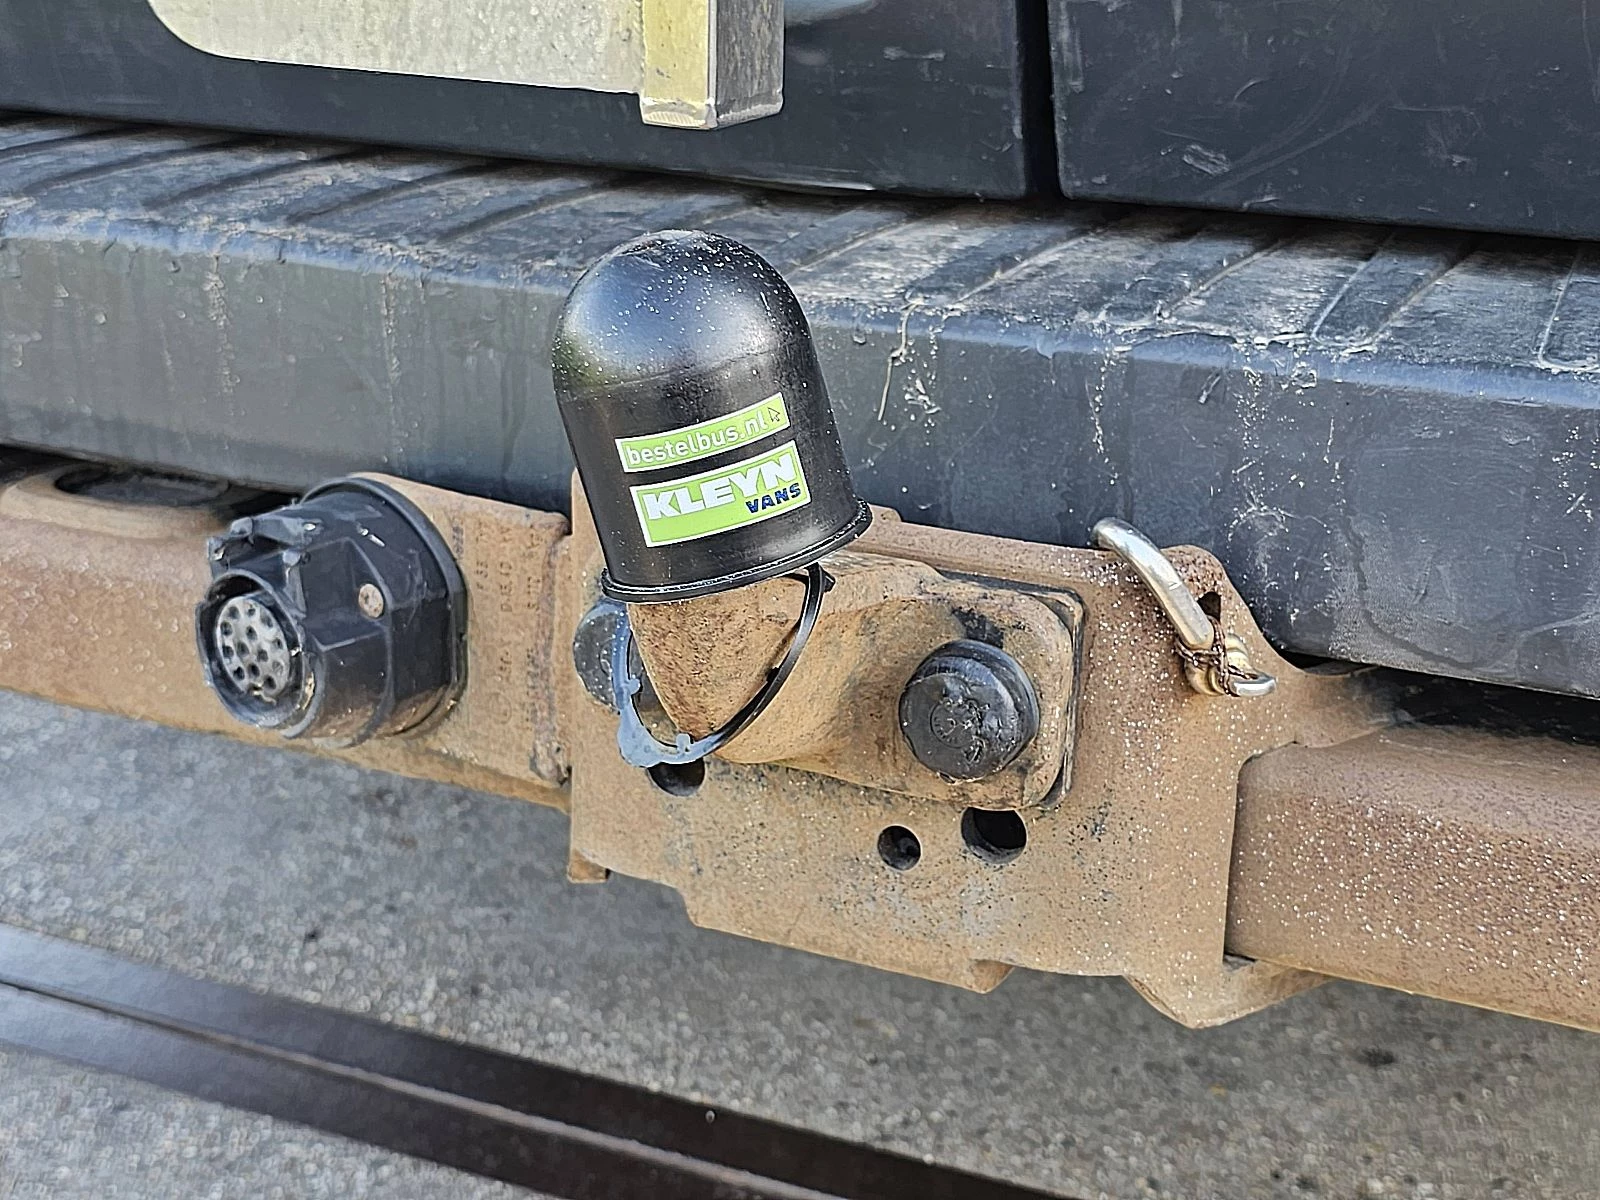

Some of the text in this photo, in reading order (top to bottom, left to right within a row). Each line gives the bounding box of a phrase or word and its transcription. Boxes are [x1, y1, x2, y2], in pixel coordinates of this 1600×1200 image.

[626, 409, 768, 465] bestelbus.nl
[642, 452, 797, 520] KLEYN
[745, 482, 801, 514] VANS
